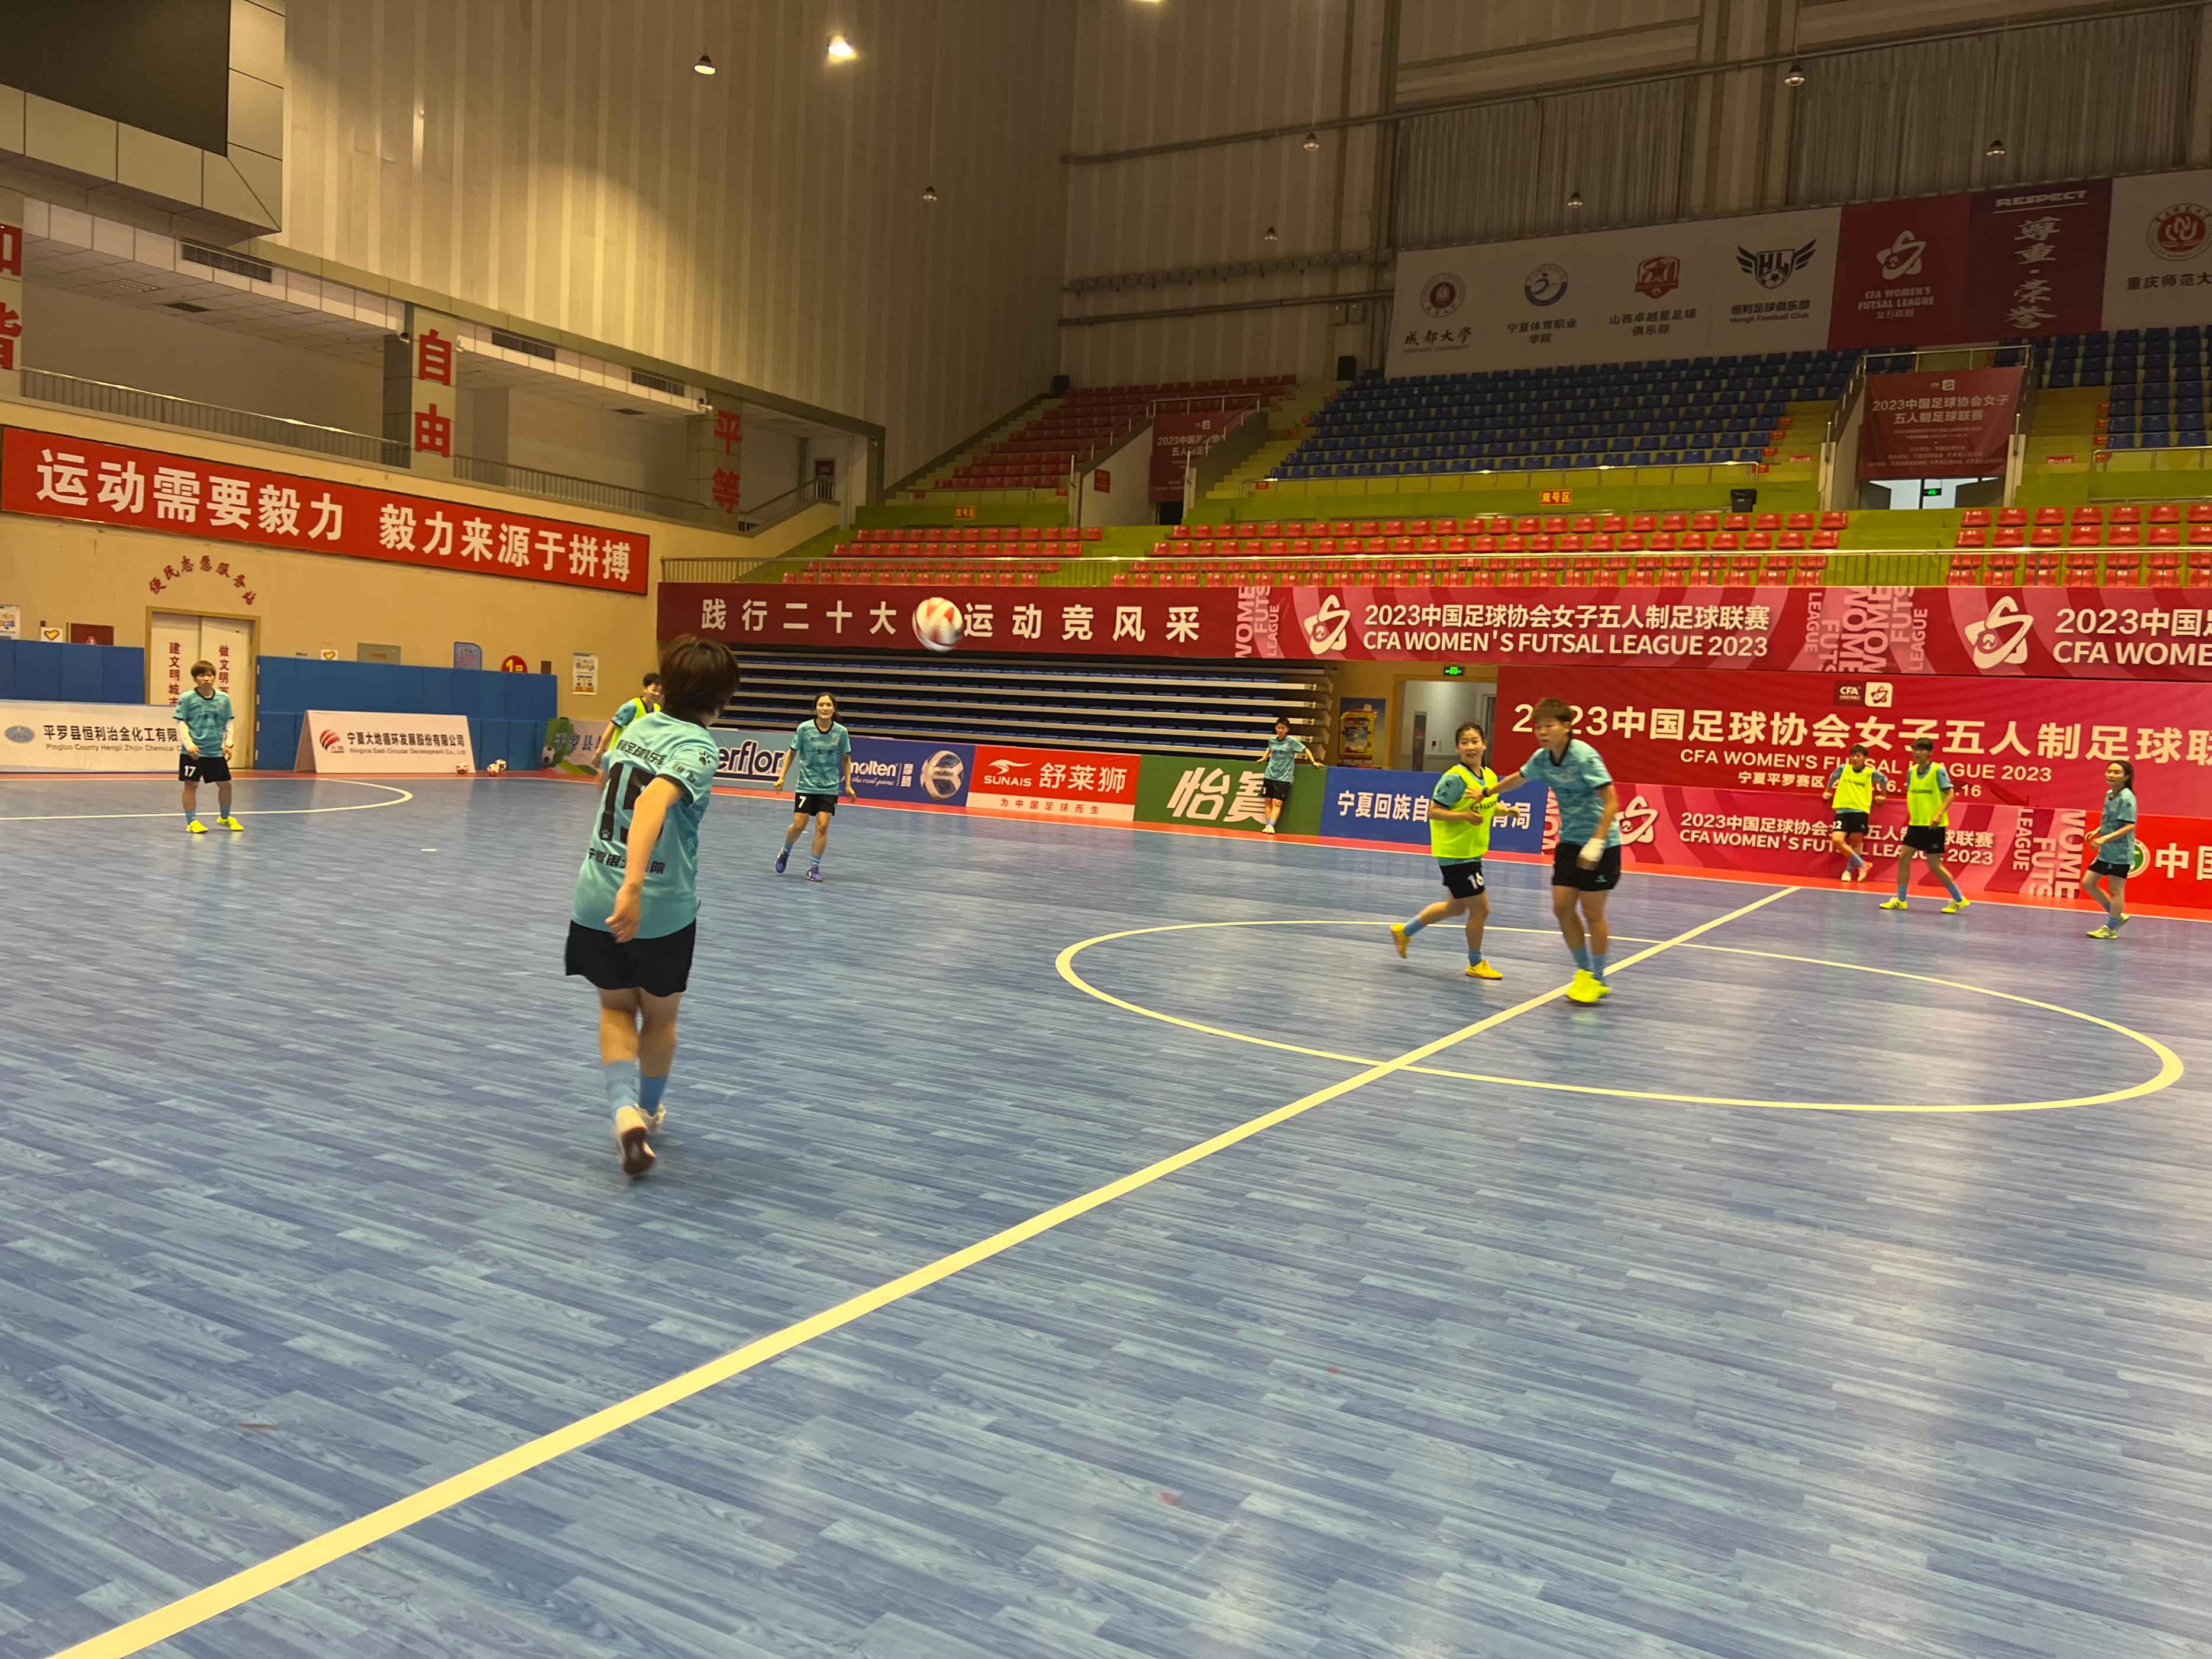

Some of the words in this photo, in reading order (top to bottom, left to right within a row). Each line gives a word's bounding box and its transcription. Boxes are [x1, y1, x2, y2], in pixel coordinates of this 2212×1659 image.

[1995, 190, 2088, 207] RESPECT
[2127, 272, 2212, 291] 重庆师范大
[1858, 298, 1894, 310] FUTSAL
[1897, 296, 1935, 308] LEAGUE
[1507, 318, 1577, 334] 宁夏体育职业
[1529, 333, 1552, 344] 学院
[1632, 324, 1670, 336] 俱乐部
[415, 329, 452, 457] 自由
[1872, 395, 2010, 412] 2023中国足球协会女子
[712, 409, 742, 514] 平等
[36, 448, 344, 540] 运动需要毅力
[379, 503, 631, 582] 毅力来源于拼搏
[701, 599, 897, 635] 践行二十大
[964, 603, 1200, 643] 运动竞风采
[1267, 605, 1280, 656] LEAGUE
[1364, 604, 1770, 631] 2023中国足球协会女子五人制足球联赛
[1805, 592, 1822, 653] LEAGUE
[2055, 608, 2212, 637] 2023中国
[1363, 631, 1402, 650] CFA
[1405, 631, 1514, 653] WOMEN'S
[1519, 632, 1604, 654] FUTSAL
[1609, 634, 1703, 656] LEAGUE
[1707, 635, 1768, 657] 2023
[1910, 608, 1928, 670] LEAGUE
[2053, 641, 2110, 664] CFA
[1840, 686, 1859, 695] CFA
[347, 731, 464, 747] 宁夏大地循环发展股份有限公司
[1512, 704, 2212, 766] 223中国足球协会女子五人制足球联
[718, 740, 785, 775] erflor
[1680, 748, 1719, 764] CFA
[1723, 751, 1817, 769] WOMEN'S
[1823, 756, 1902, 774] FUSAL
[2001, 765, 2052, 782] 2023
[184, 766, 196, 777] 17
[984, 774, 1032, 787] SUNAIS
[1039, 763, 1128, 794] 舒莱狮
[1738, 770, 1825, 788] 宁夏平罗赛区
[797, 795, 806, 808] 7
[1000, 798, 1099, 815] 为中国足球而生
[1338, 790, 1531, 830] 宁夏回族自育局
[1680, 830, 1710, 844] CFA
[1947, 848, 1993, 865] 2023
[2013, 808, 2034, 871] LEAGUE
